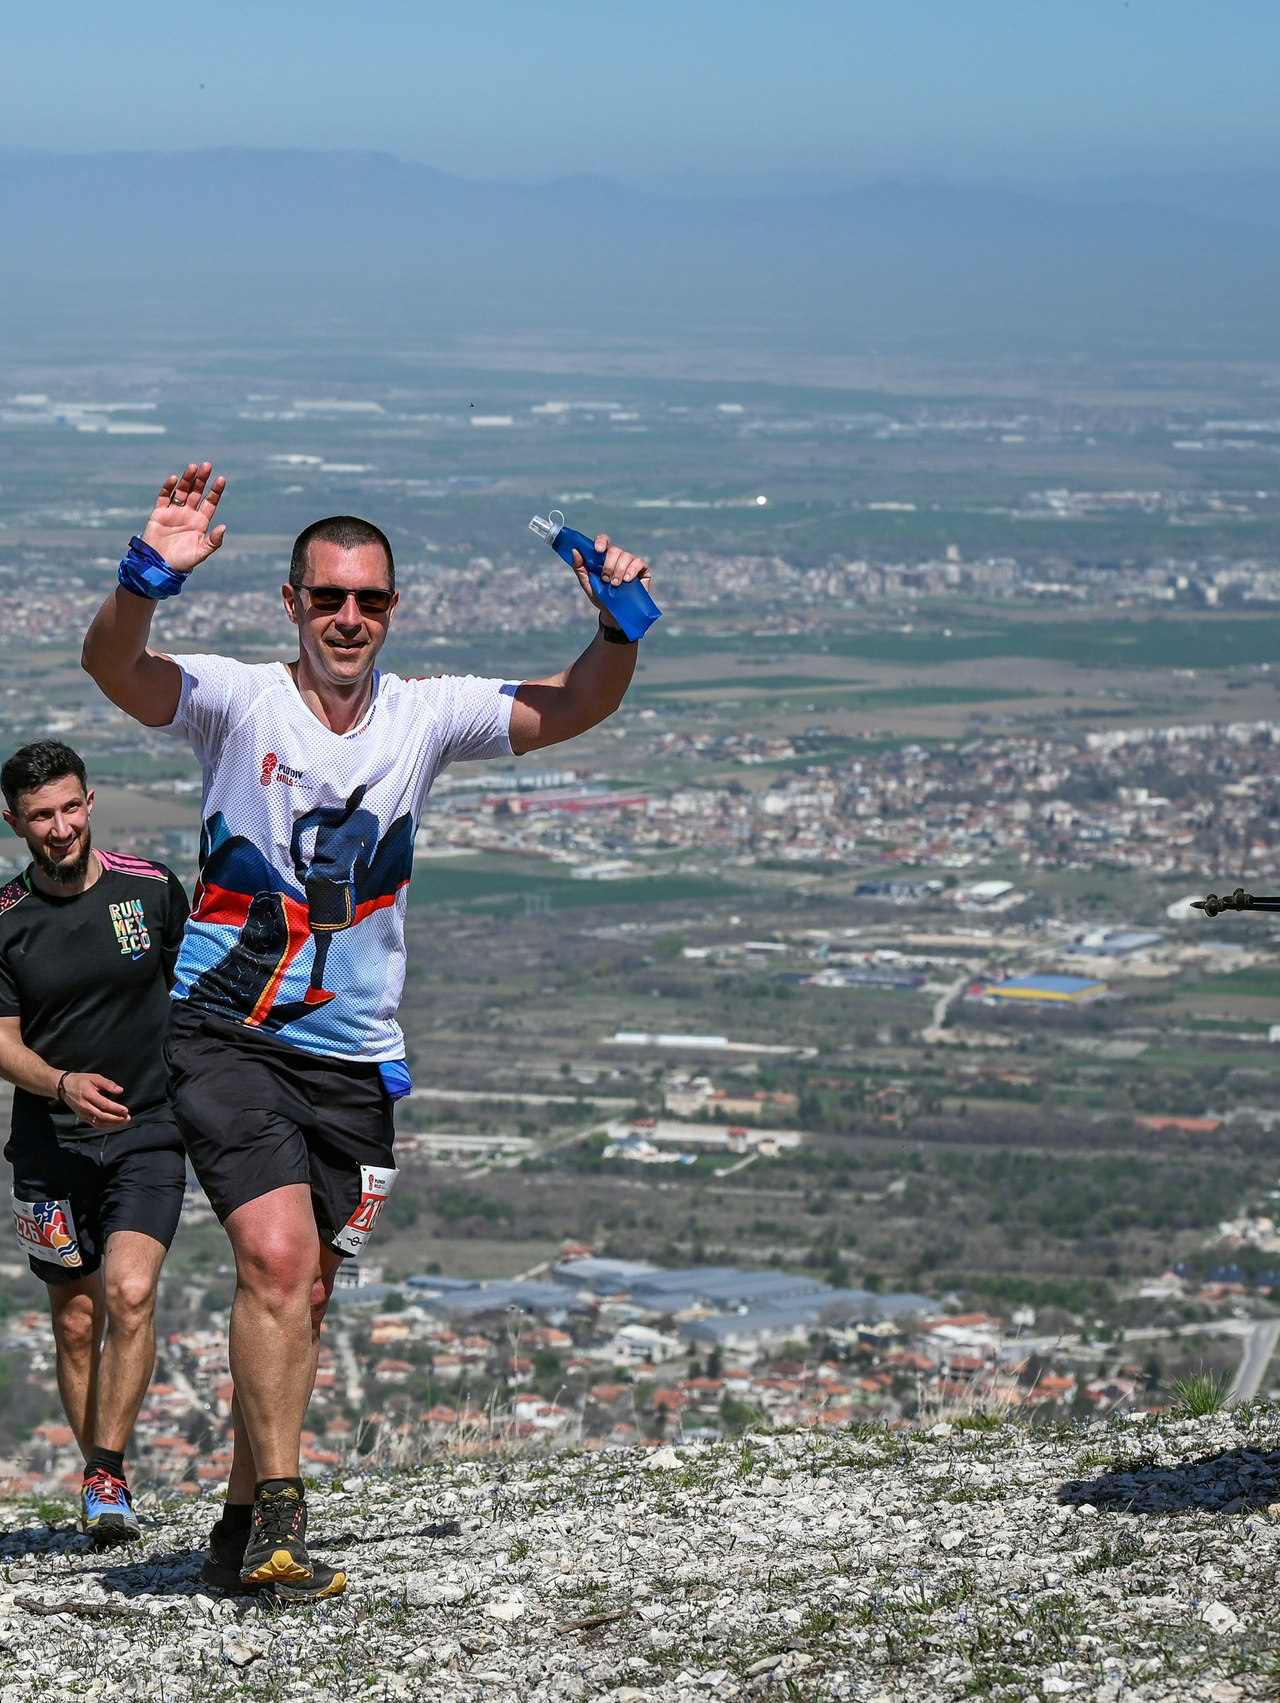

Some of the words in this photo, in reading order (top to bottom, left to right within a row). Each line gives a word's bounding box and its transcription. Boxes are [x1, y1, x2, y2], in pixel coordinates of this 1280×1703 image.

[108, 899, 144, 921] RUN
[113, 915, 148, 938] MEX
[118, 932, 151, 955] ICO
